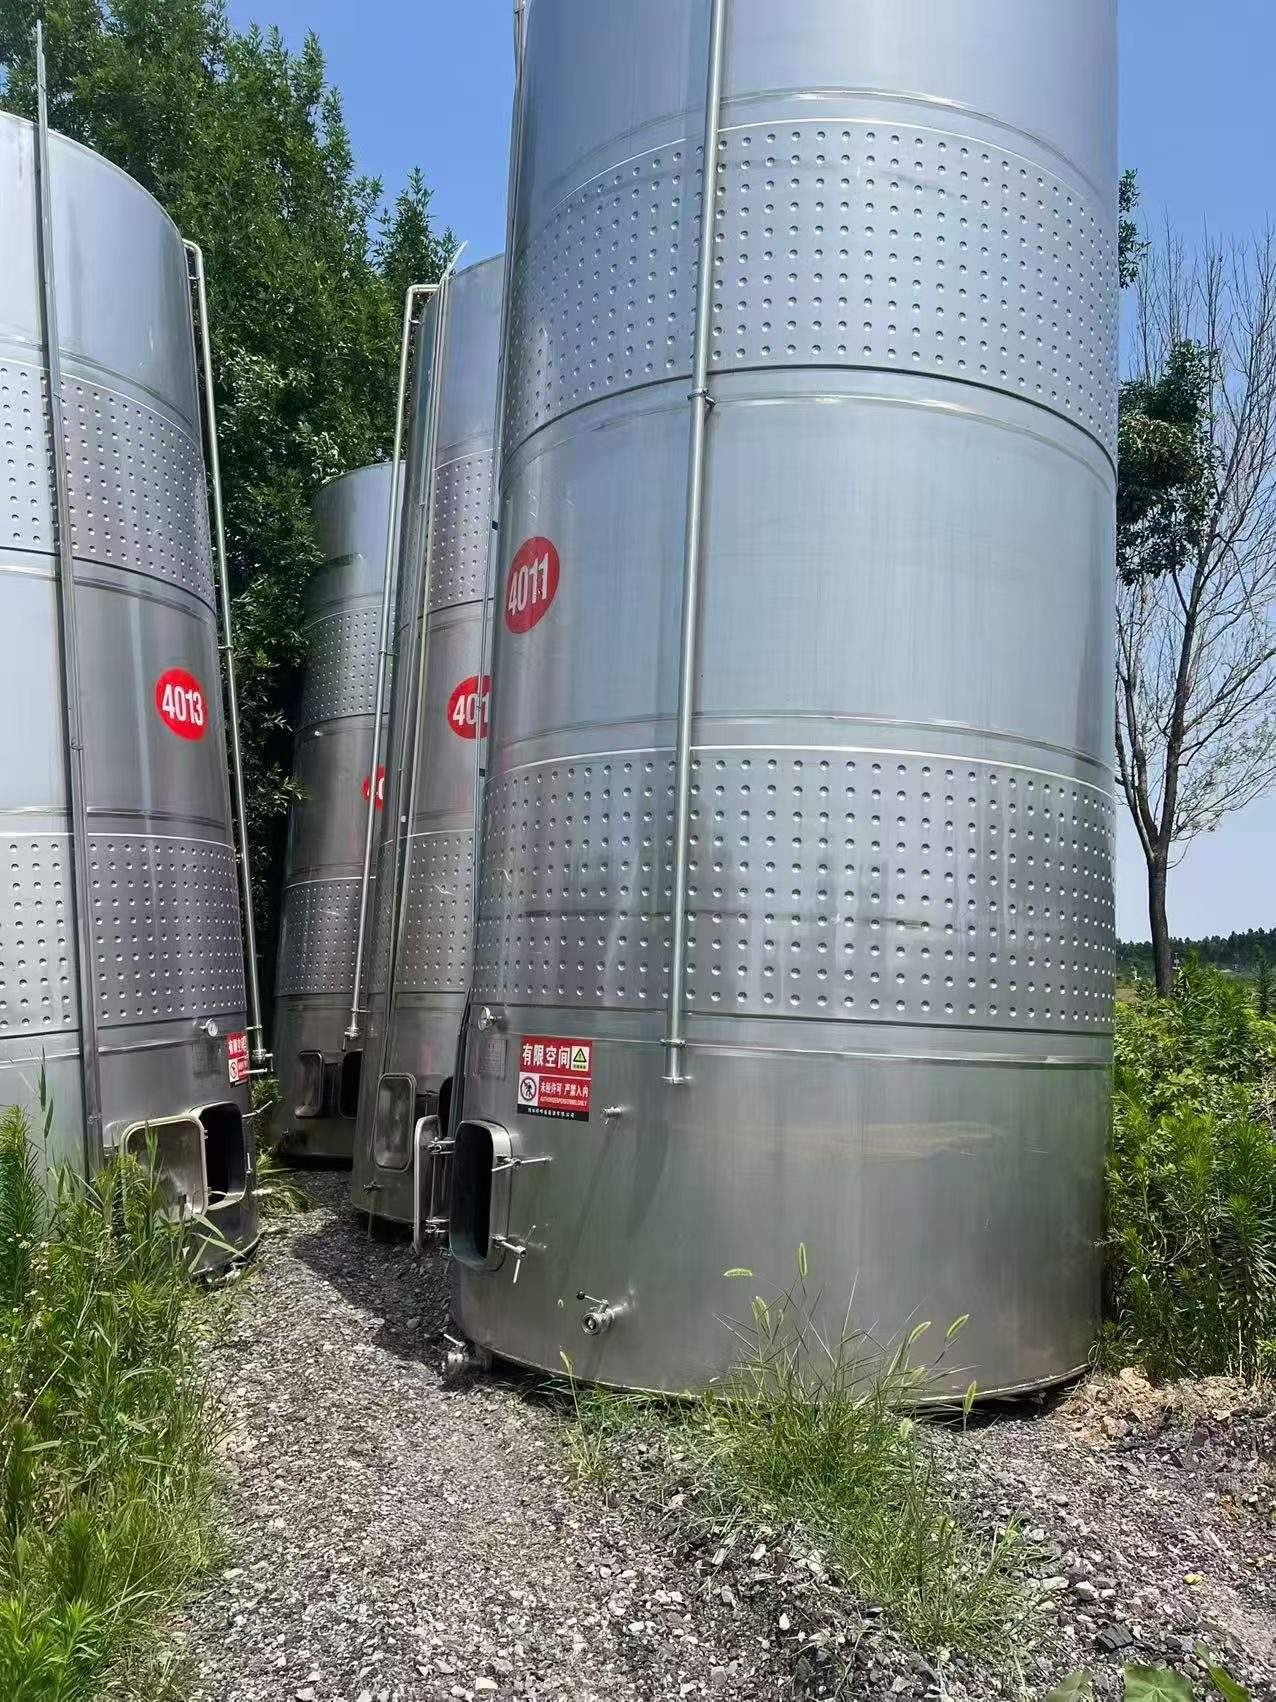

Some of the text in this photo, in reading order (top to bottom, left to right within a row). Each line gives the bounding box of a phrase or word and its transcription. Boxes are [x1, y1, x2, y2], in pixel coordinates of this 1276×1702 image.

[508, 552, 549, 616] 4011
[162, 684, 203, 726] 4013
[453, 692, 489, 726] 401
[522, 1043, 570, 1069] 有限空间
[540, 1082, 589, 1098] 未经许可 严禁入内
